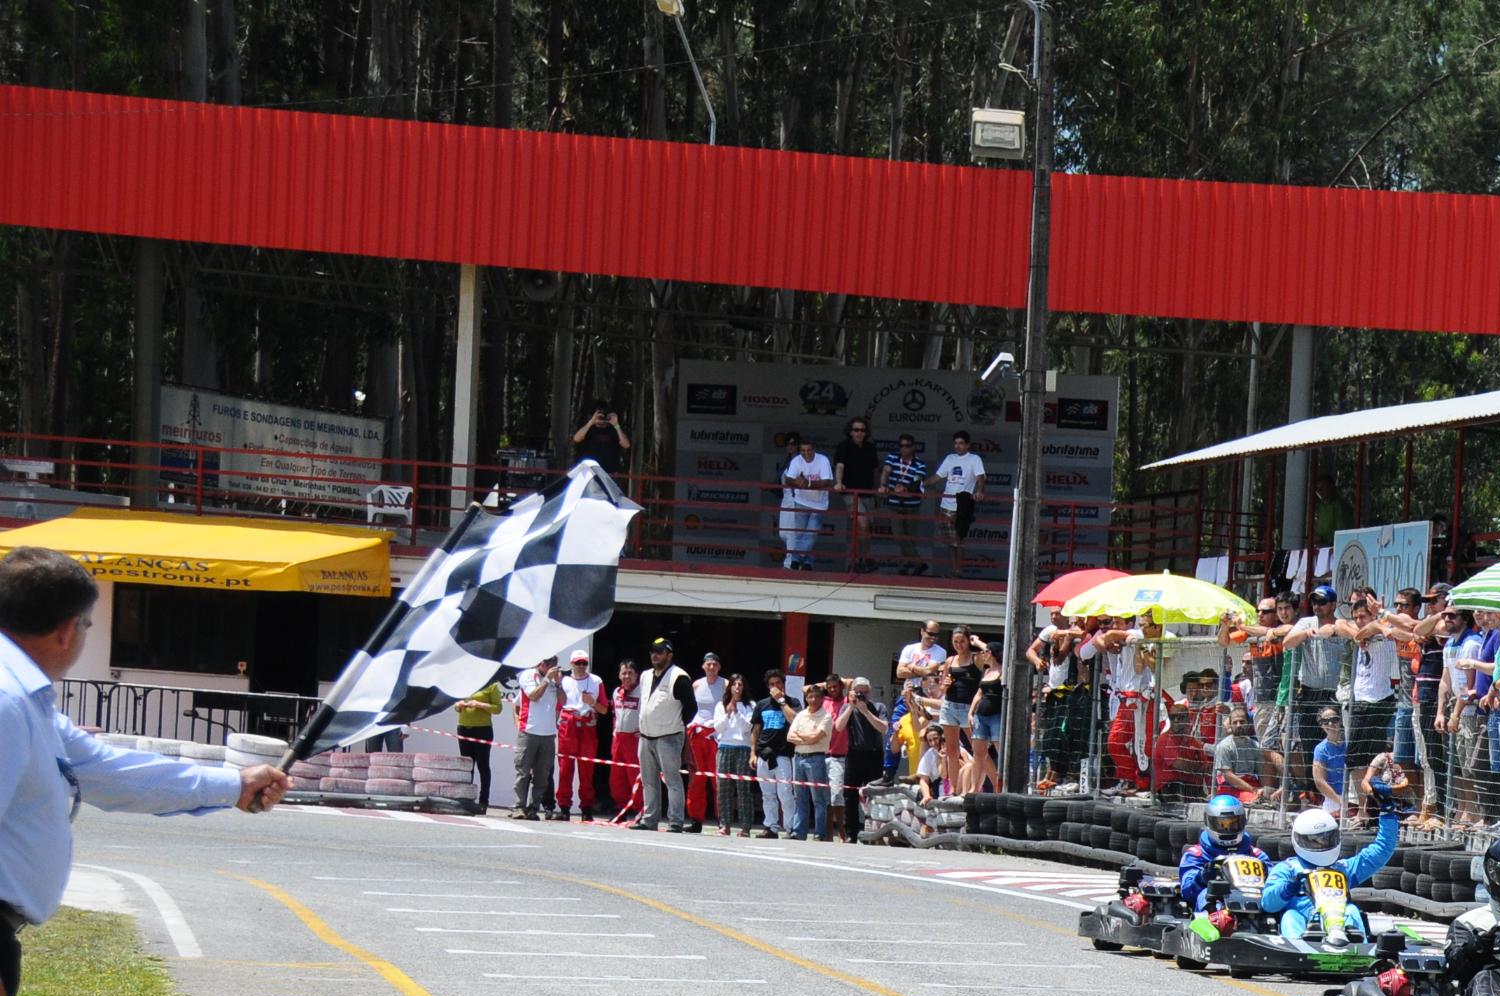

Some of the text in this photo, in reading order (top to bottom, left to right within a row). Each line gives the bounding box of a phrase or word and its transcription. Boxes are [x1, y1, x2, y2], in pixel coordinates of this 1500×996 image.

[743, 395, 789, 405] HONDA
[914, 377, 965, 423] KARTING
[212, 403, 242, 419] FUROS
[243, 410, 249, 421] E
[251, 411, 302, 429] SONDAGENS
[303, 419, 315, 432] DE
[889, 413, 942, 423] EUROINDY
[1042, 444, 1100, 456] ubrifatima
[697, 457, 739, 471] HELIX
[1046, 473, 1088, 485] HELIX
[77, 553, 209, 572] ALANÇAS
[91, 567, 252, 588] pestronix.pt
[320, 570, 368, 582] BALANÇAS
[1234, 860, 1262, 877] 138
[1311, 872, 1344, 889] 128
